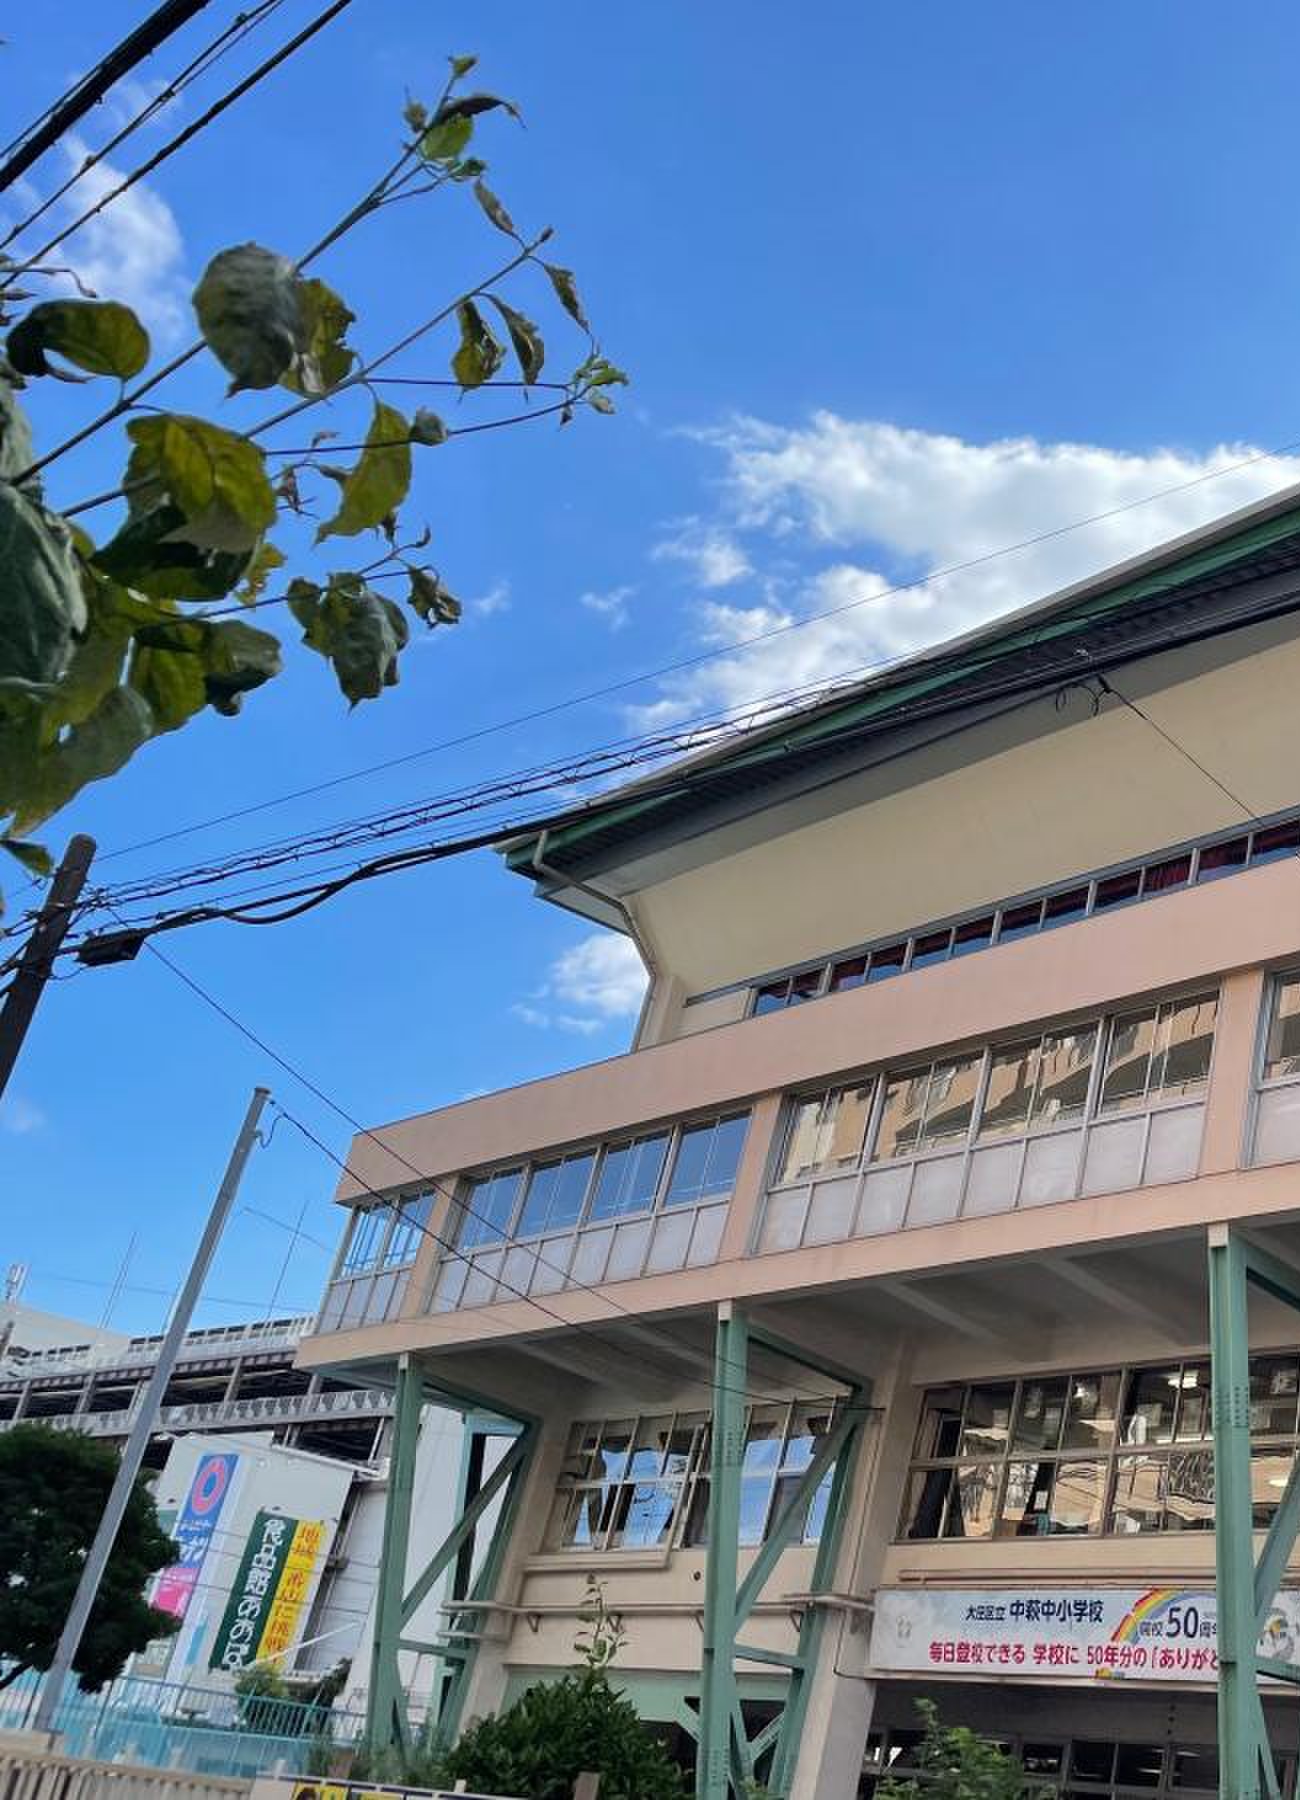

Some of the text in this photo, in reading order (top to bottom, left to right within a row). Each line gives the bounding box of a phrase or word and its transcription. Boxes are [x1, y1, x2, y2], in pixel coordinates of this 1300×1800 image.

[1009, 1598, 1104, 1623] 中萩中小学校
[929, 1644, 1025, 1665] 毎日登校できる
[1033, 1645, 1079, 1665] 学校に
